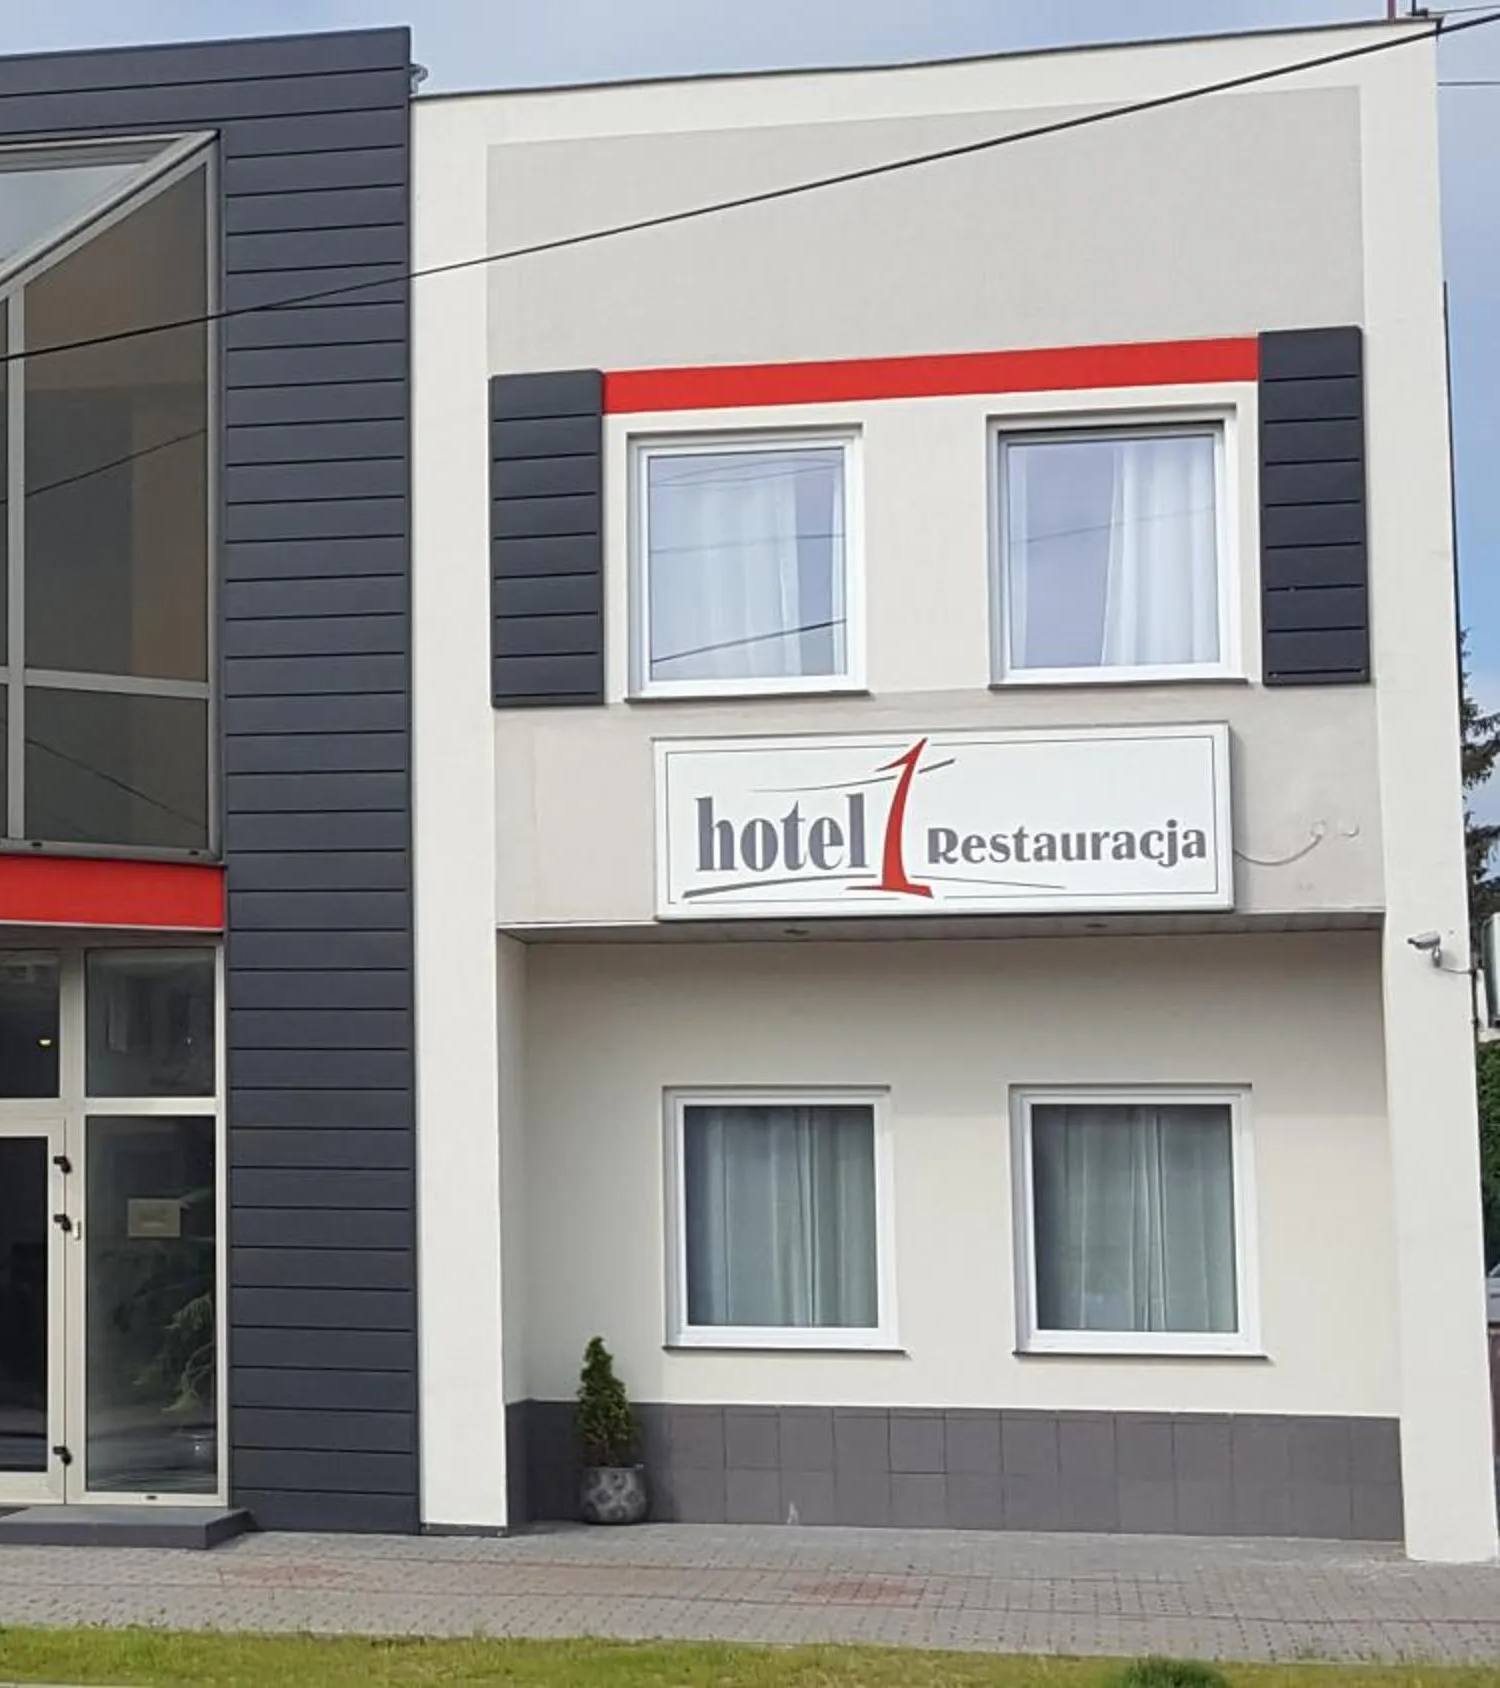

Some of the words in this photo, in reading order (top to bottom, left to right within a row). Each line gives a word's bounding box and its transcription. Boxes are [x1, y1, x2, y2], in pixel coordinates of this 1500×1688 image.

[695, 793, 869, 872] hotel
[845, 737, 934, 899] 1
[927, 820, 1207, 868] Restauracja
